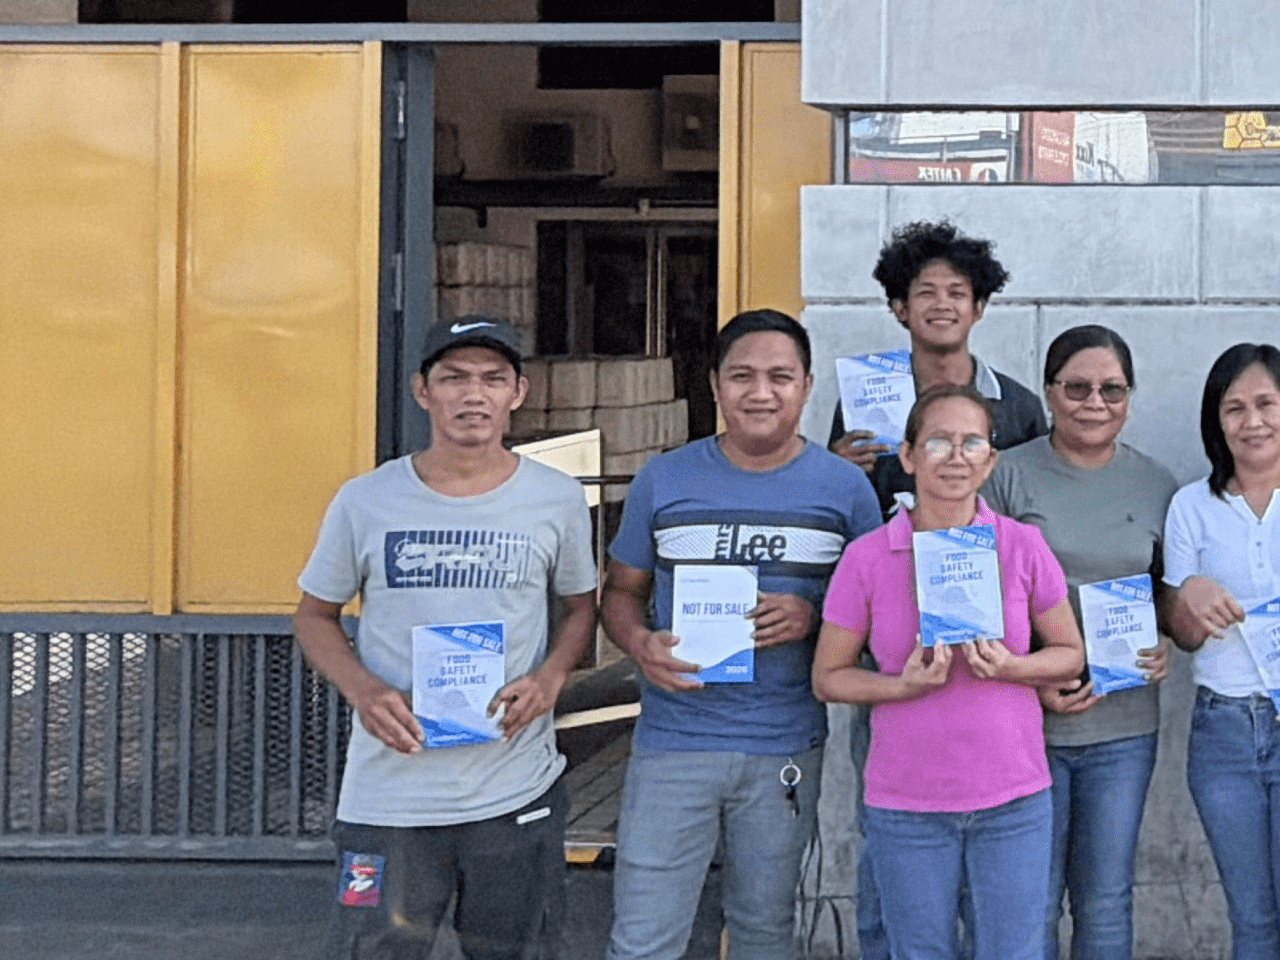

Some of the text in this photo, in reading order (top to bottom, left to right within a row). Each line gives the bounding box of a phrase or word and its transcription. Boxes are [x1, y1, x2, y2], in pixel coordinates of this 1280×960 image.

[940, 562, 973, 573] SAFETY
[929, 570, 984, 586] COMPLIANCE
[682, 603, 748, 615] NOT FOR SALE
[1105, 614, 1134, 628] SAFETY
[1096, 623, 1143, 639] COMPLIANCE
[441, 664, 477, 676] SAFETY
[428, 674, 487, 688] COMPLIANCE
